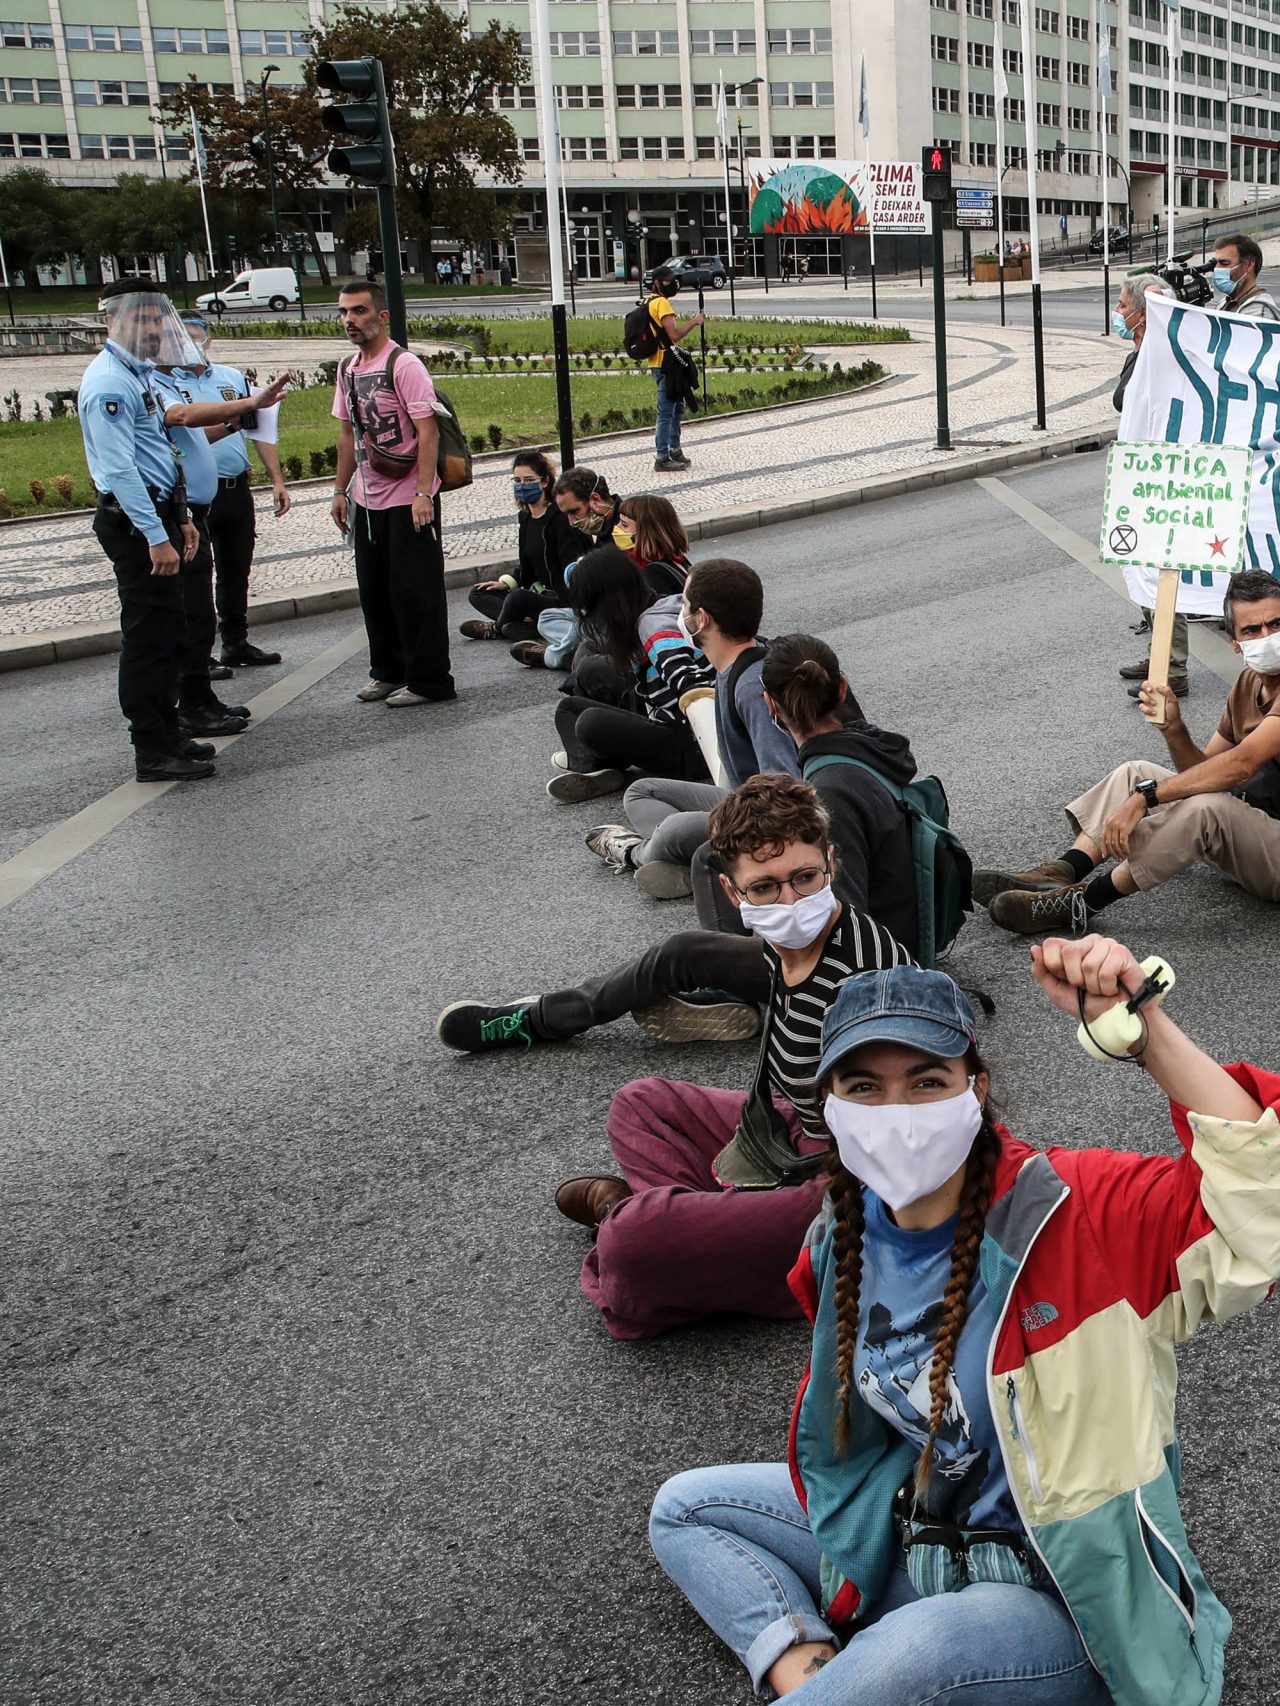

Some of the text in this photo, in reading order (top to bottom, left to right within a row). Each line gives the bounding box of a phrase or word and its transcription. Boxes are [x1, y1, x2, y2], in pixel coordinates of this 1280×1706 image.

[869, 163, 914, 183] CLIMA
[875, 184, 916, 197] SEM LEI
[874, 199, 921, 211] É DEIXAR A
[872, 212, 925, 223] CASA ARDER
[1132, 480, 1233, 501] ambiental
[1115, 505, 1130, 522] e
[1165, 528, 1174, 555] !
[1020, 1312, 1042, 1326] ORTH
[1024, 1318, 1046, 1333] FACE
